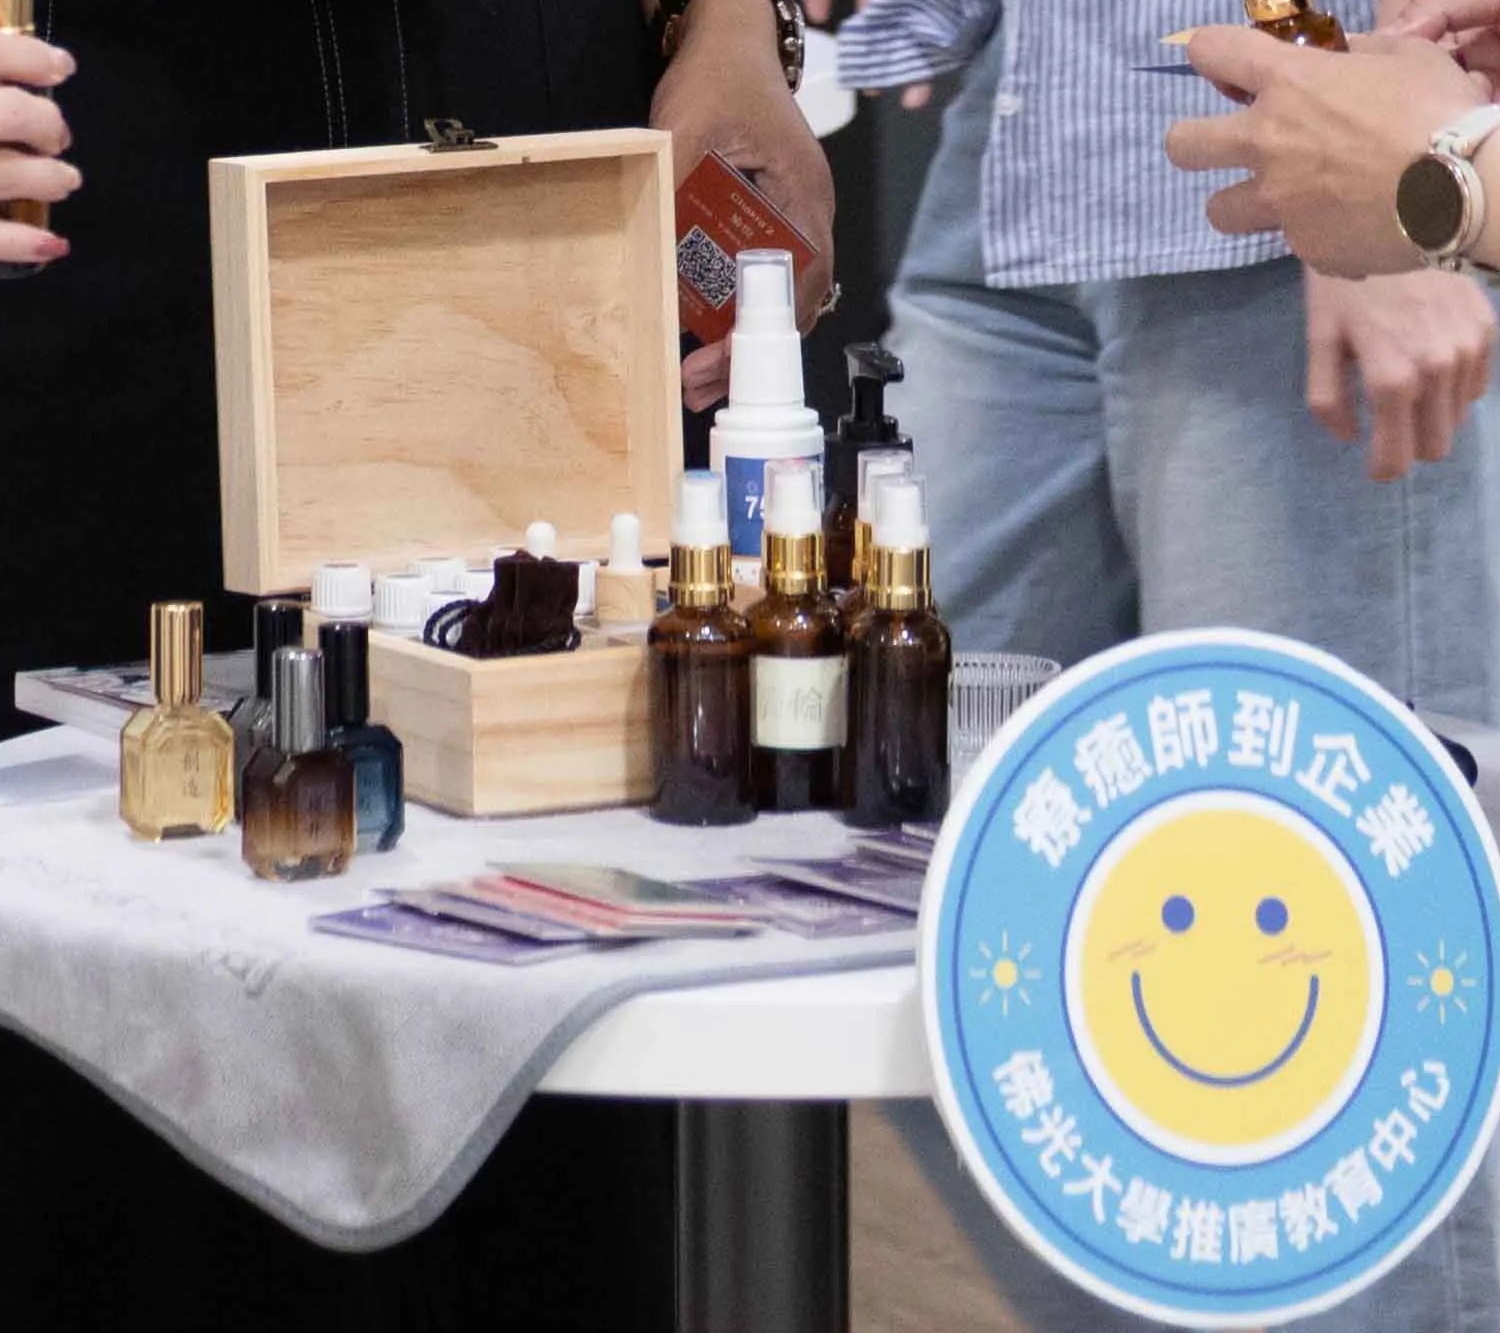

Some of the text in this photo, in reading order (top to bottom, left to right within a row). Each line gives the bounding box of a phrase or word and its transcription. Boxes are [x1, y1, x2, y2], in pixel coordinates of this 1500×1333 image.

[1012, 688, 1435, 878] 療癒師到企業
[994, 1050, 1452, 1265] 佛光大學推廣教育中心
